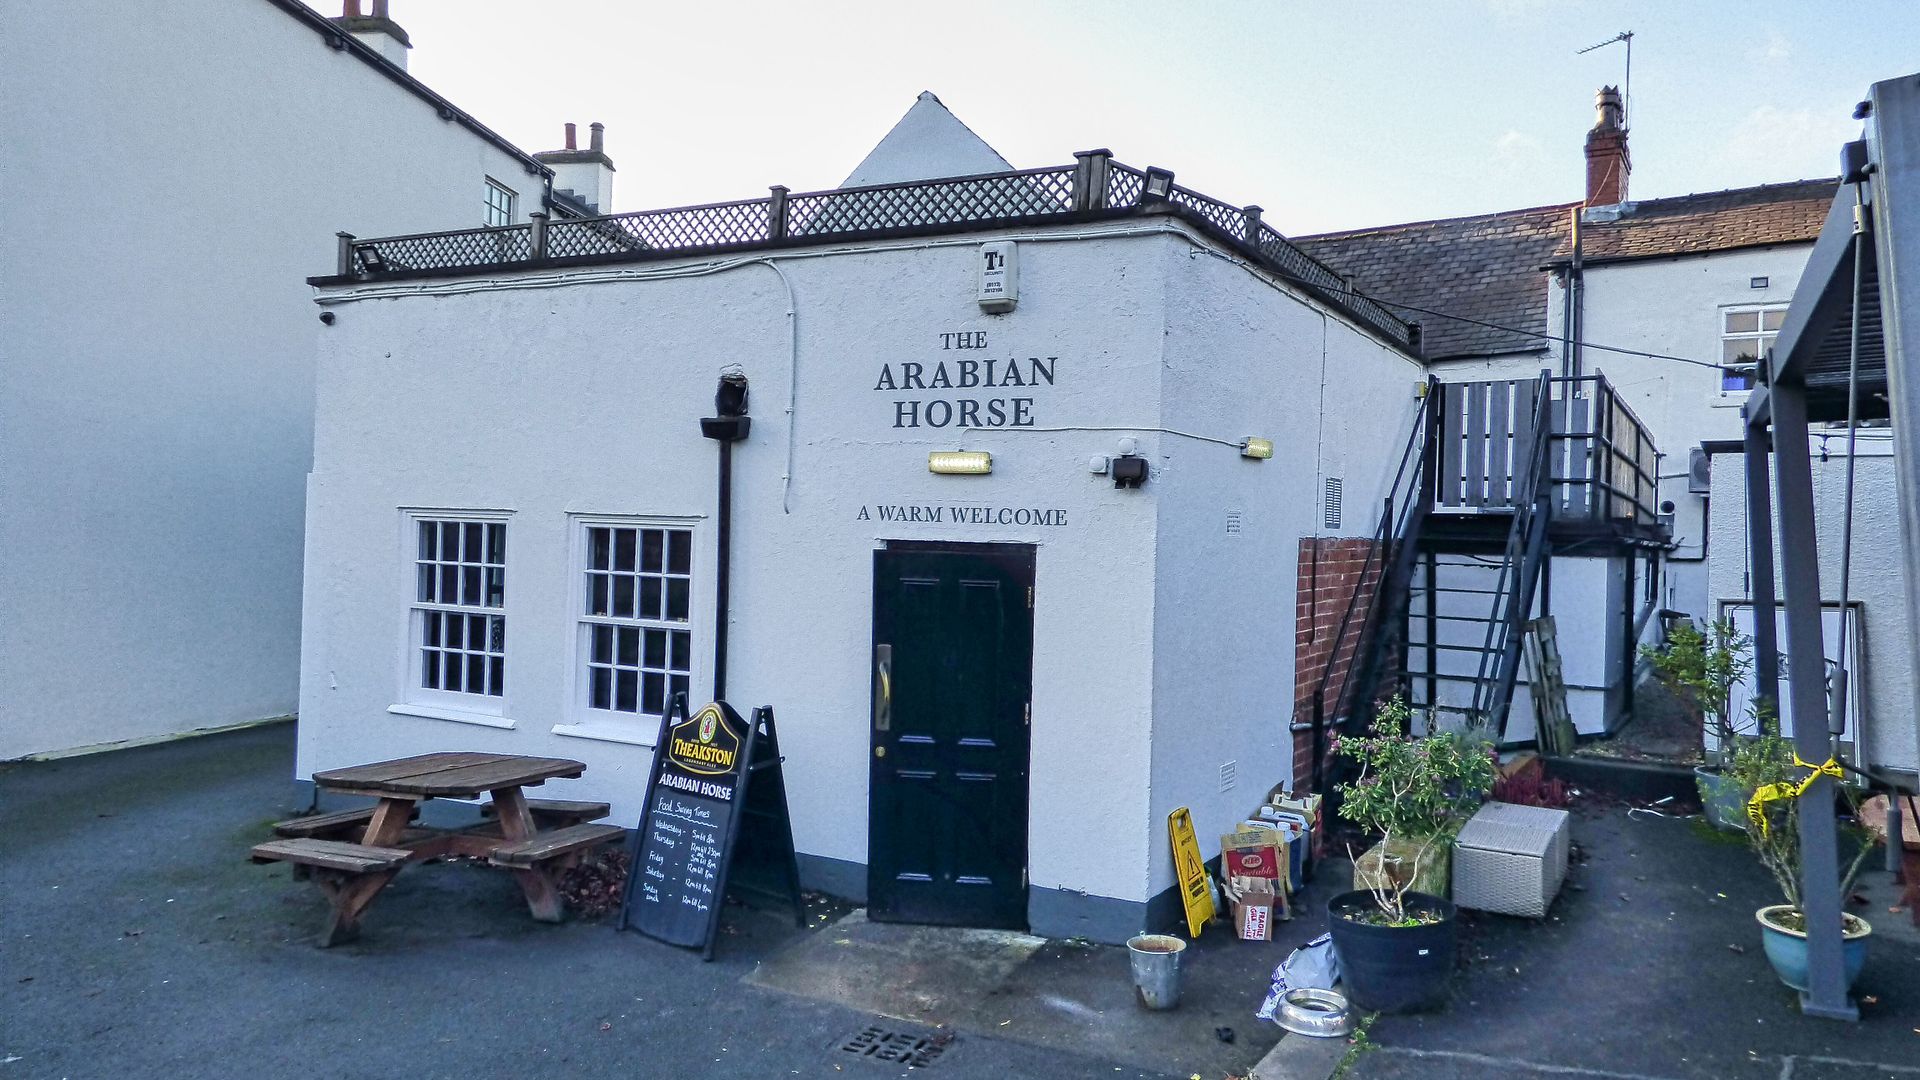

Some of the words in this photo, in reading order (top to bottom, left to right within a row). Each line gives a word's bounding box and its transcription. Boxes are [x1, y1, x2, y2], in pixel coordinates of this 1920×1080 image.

[940, 331, 988, 350] THE
[874, 357, 1058, 390] ARABIAN
[892, 398, 1035, 428] HORSE
[857, 505, 870, 521] A
[877, 505, 943, 523] WARM
[950, 507, 1068, 527] WELCOME
[674, 738, 733, 766] THEAKSTON
[659, 773, 700, 793] ARABIAN
[700, 782, 732, 800] HORSE
[658, 797, 672, 812] Food
[654, 832, 674, 848] Thursday
[649, 851, 664, 866] Friday
[1257, 911, 1266, 937] FRAGILE
